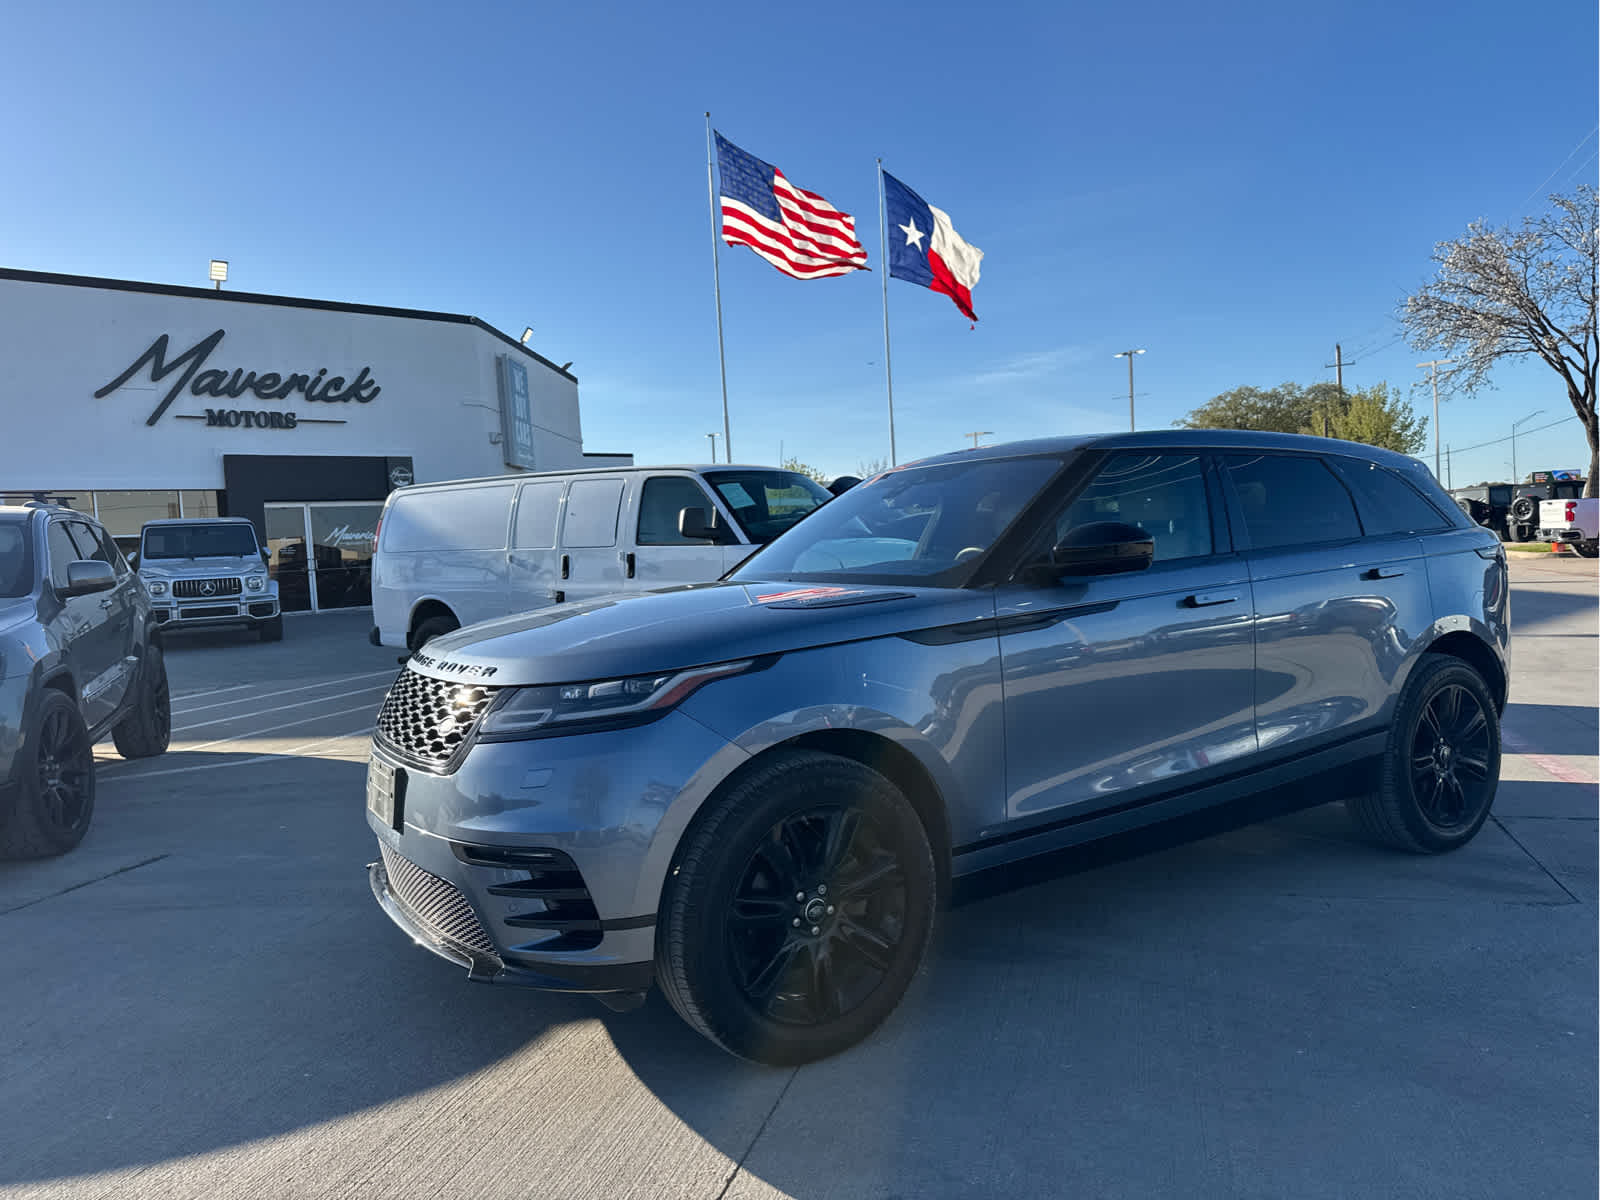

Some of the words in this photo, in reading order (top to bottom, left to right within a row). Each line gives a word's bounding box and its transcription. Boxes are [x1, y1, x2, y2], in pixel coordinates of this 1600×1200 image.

[94, 329, 381, 426] Maverick
[205, 409, 297, 429] MOTORS
[324, 524, 375, 547] Maveric
